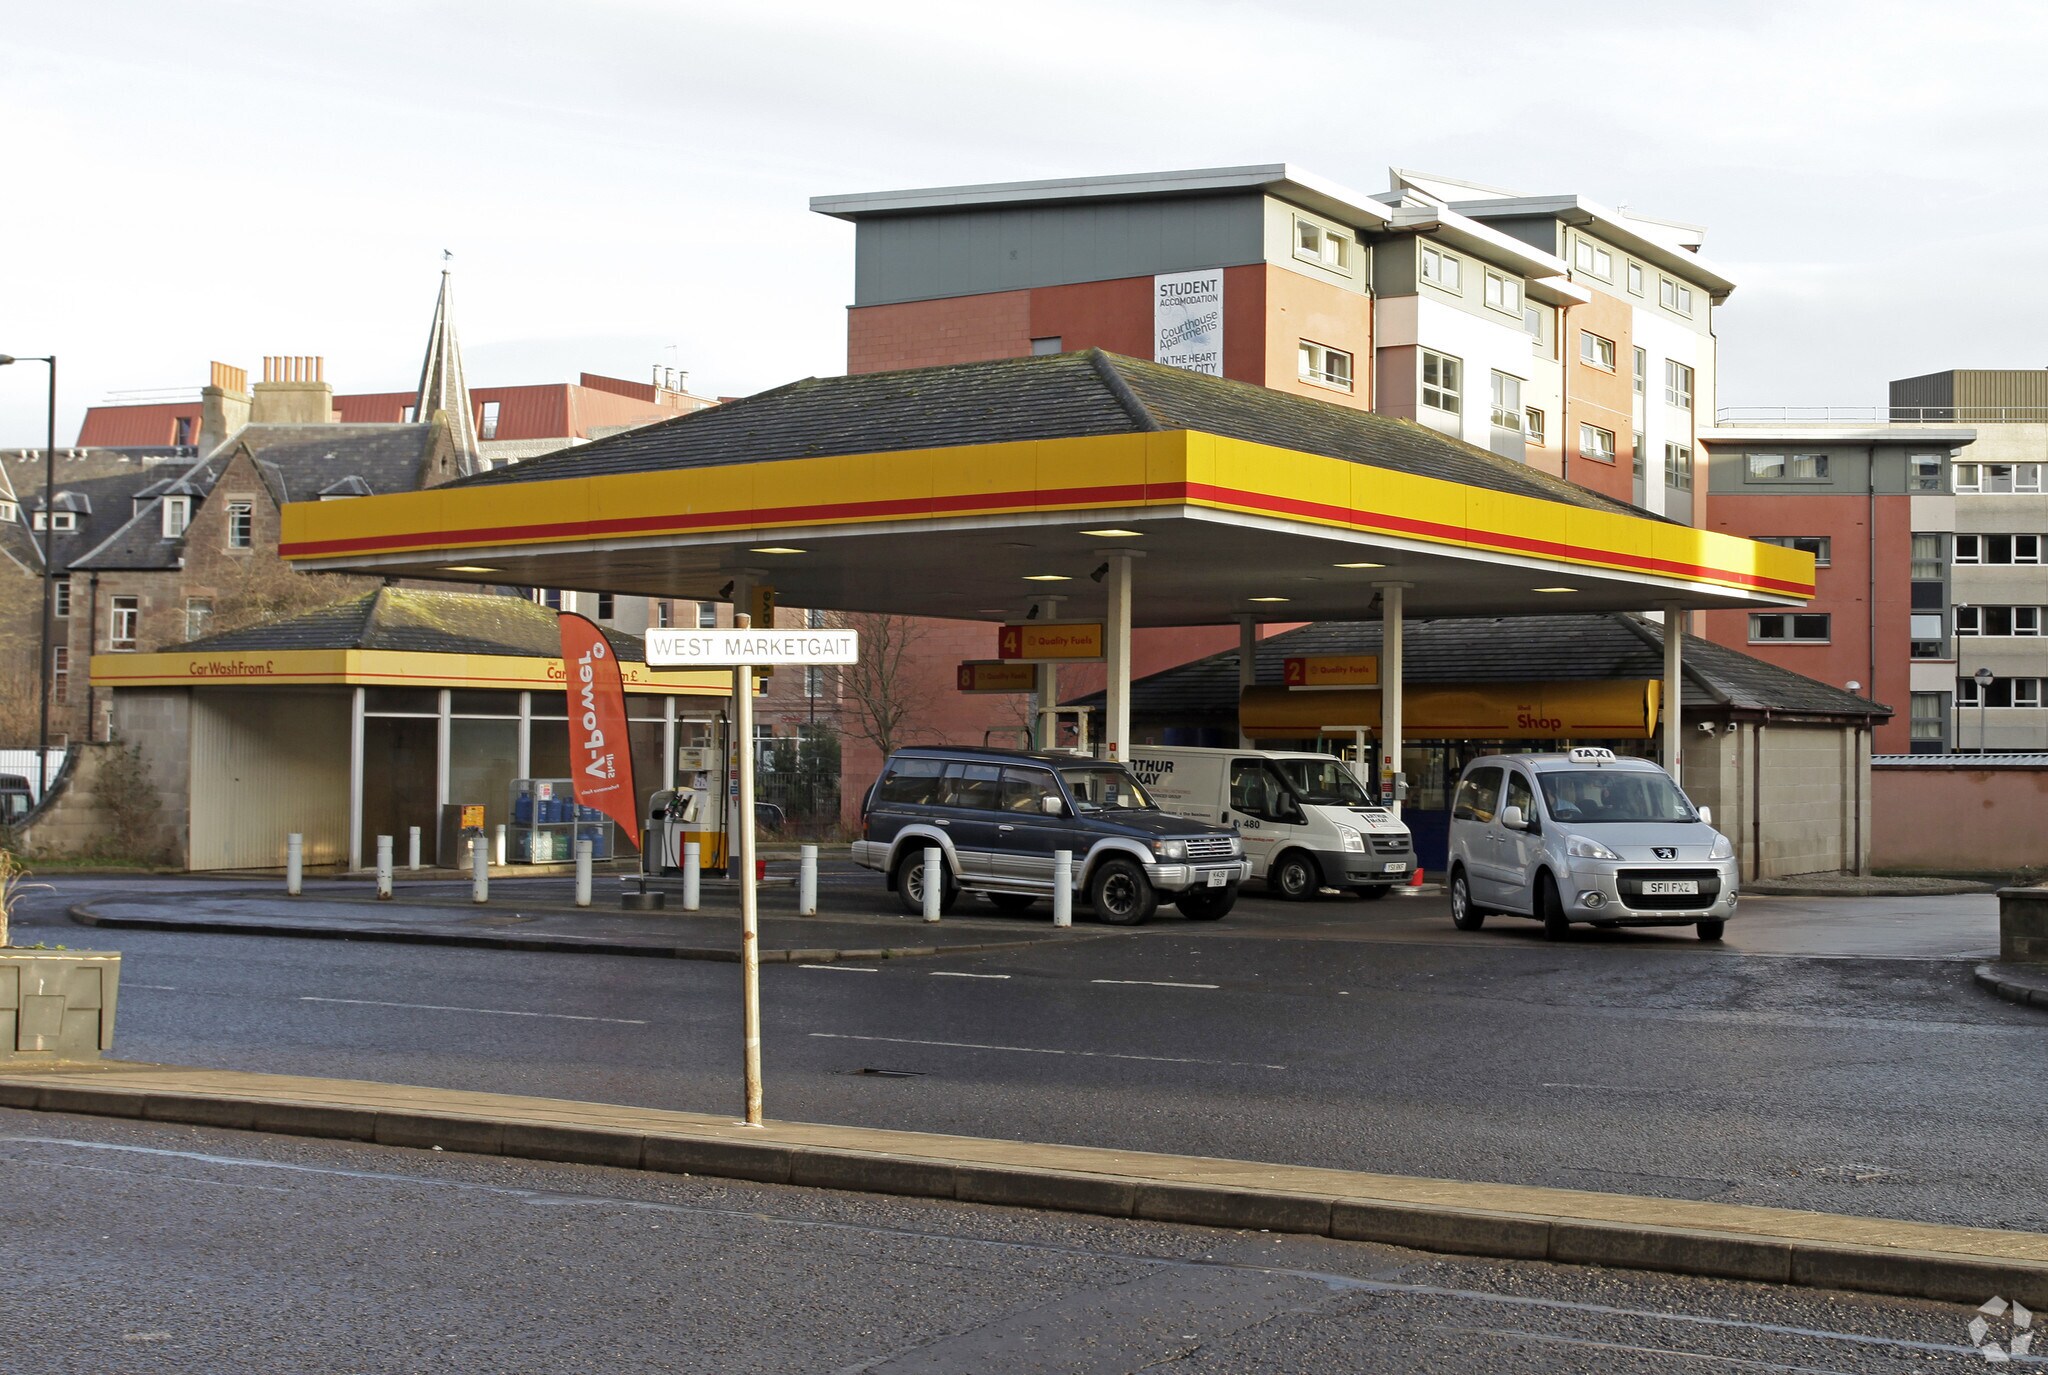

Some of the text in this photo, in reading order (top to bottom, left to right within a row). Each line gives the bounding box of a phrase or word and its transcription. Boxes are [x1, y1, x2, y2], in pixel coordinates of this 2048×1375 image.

[1160, 279, 1217, 296] STUDENT
[1160, 294, 1219, 307] ACCOMODATION
[1161, 311, 1218, 340] Courthouse
[1159, 320, 1217, 351] Apartments
[1160, 351, 1217, 365] IN THE HEART
[1194, 363, 1217, 374] CITY
[762, 590, 771, 629] ave
[653, 638, 851, 656] WEST MARKETGAIT
[1003, 631, 1093, 653] 4 Quality Fuels
[189, 661, 208, 675] Car
[208, 660, 238, 675] Wash
[238, 660, 265, 674] From
[1288, 661, 1300, 681] 2
[1320, 666, 1347, 675] Quality
[960, 669, 971, 687] 8
[1517, 714, 1562, 732] Shop
[1574, 749, 1612, 758] TAXI
[1129, 758, 1175, 773] RTHUR
[1243, 820, 1260, 829] 480
[1671, 883, 1690, 892] FXZ
